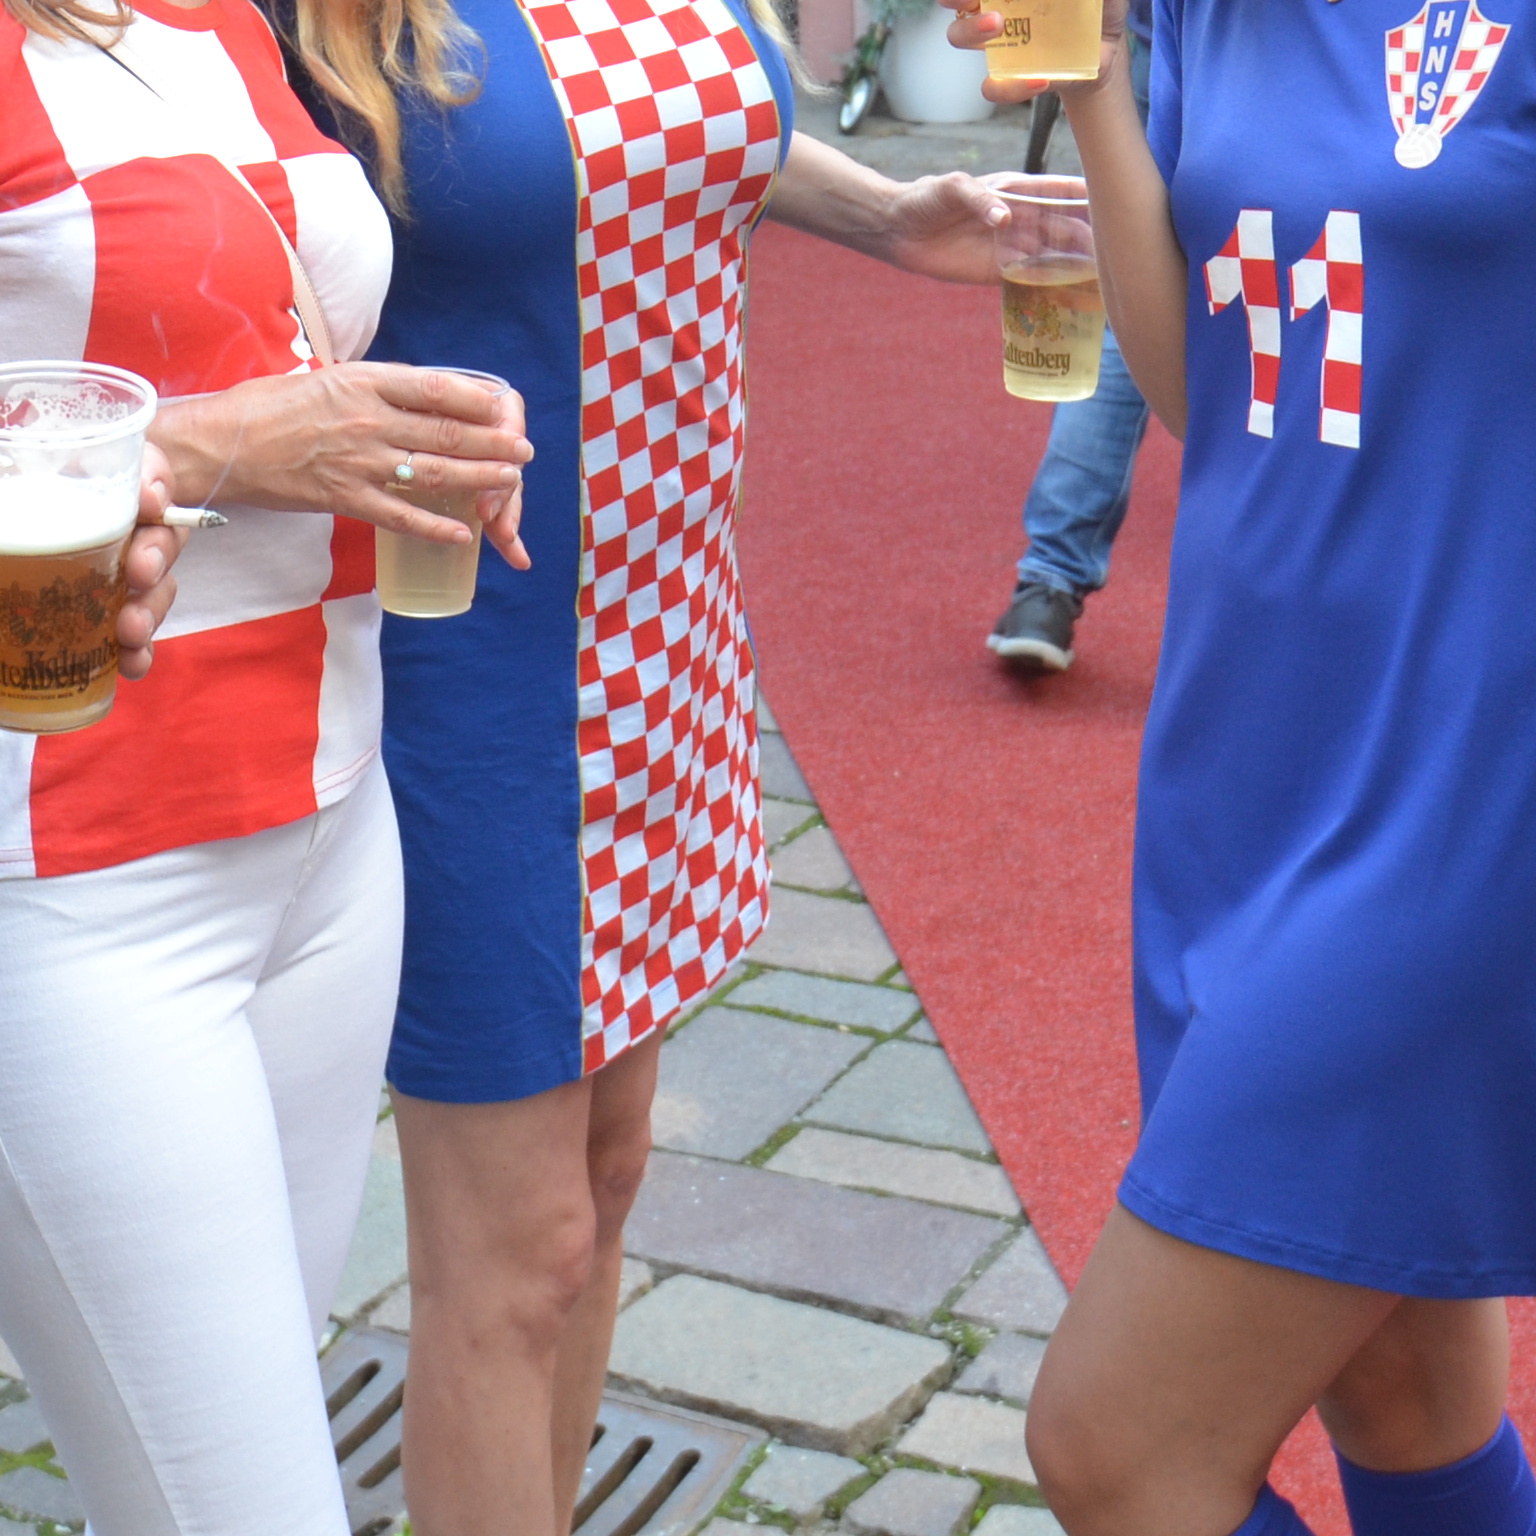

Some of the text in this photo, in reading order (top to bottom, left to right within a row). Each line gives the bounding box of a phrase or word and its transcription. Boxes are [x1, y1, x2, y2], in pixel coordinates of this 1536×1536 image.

[1418, 9, 1456, 112] HNS
[1004, 342, 1071, 376] altenberg
[1202, 207, 1364, 449] 11
